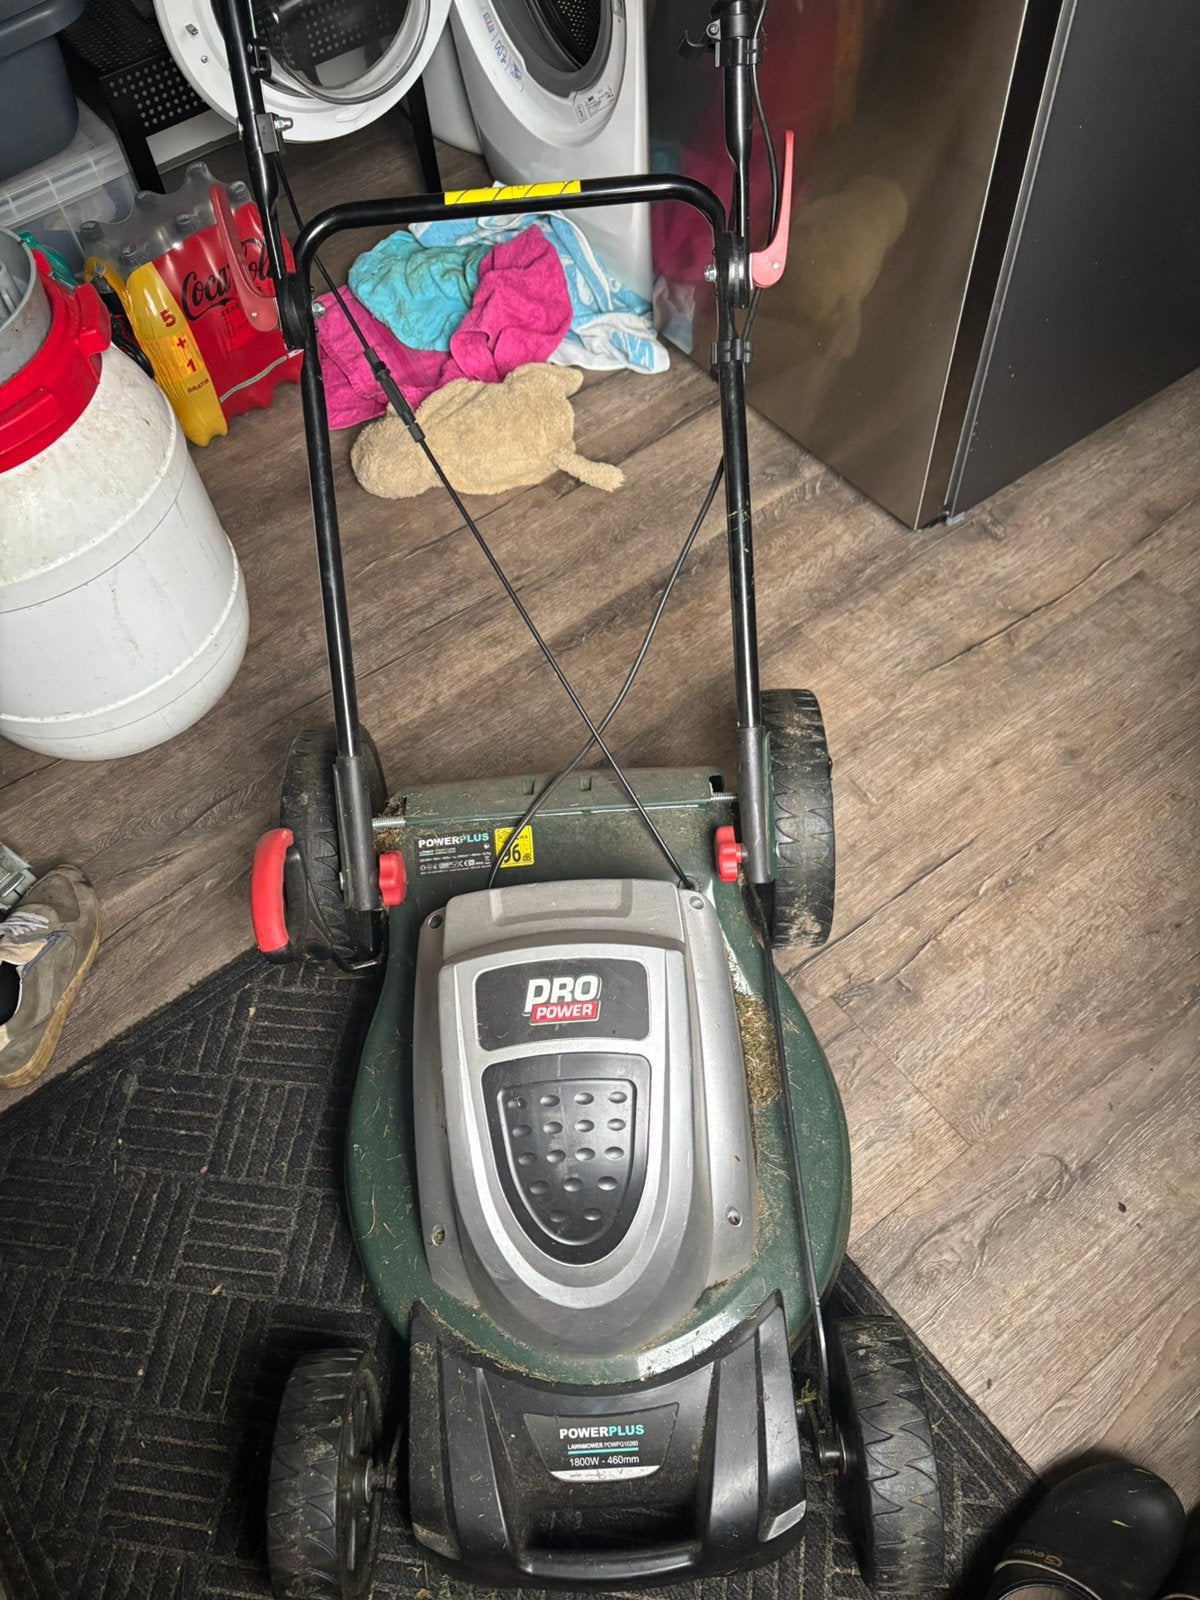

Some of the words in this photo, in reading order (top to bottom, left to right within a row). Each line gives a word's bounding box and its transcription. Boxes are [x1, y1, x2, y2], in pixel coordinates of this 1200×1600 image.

[160, 309, 176, 328] 5
[186, 358, 198, 373] 1
[187, 378, 210, 394] GRATIS
[418, 832, 490, 848] POWERPLUS
[524, 975, 599, 1013] PRO
[535, 1003, 593, 1020] POWER
[559, 1424, 645, 1440] POWERPLUS
[567, 1441, 603, 1451] LAWNMOWER
[569, 1456, 600, 1467] 1800W
[607, 1454, 640, 1466] 460mm
